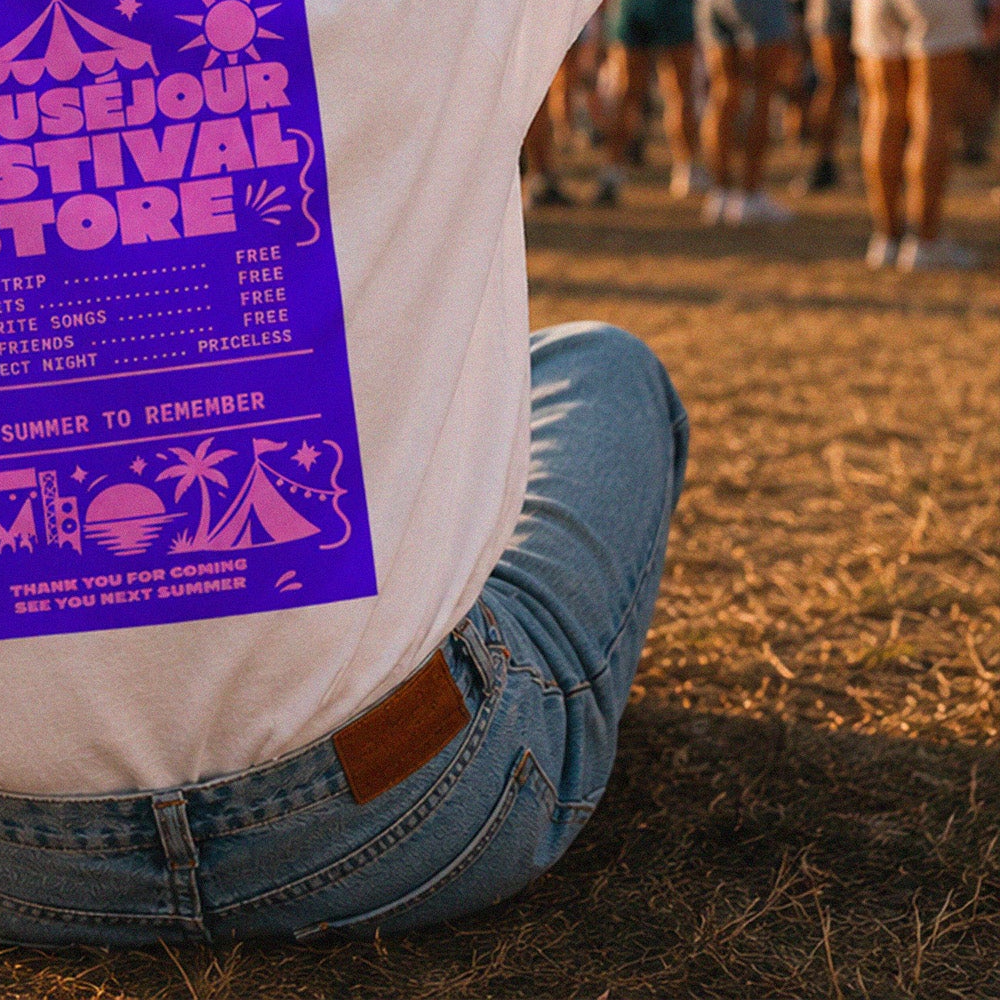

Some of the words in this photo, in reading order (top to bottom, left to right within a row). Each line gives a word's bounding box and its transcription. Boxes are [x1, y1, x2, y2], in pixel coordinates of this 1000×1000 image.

[1, 274, 46, 292] TRIP
[236, 246, 281, 264] FREE
[238, 267, 283, 285] FREE
[50, 310, 107, 329] SONGS
[240, 288, 286, 306] FREE
[243, 309, 288, 327] FREE
[43, 353, 97, 372] NIGHT
[198, 329, 292, 353] PRICELESS
[1, 415, 89, 443] SUMMER
[102, 409, 132, 430] TO
[145, 391, 265, 425] REMEMBER
[9, 579, 78, 597] THANK
[82, 574, 122, 589] YOU
[127, 569, 165, 584] FOR
[170, 558, 247, 579] COMING
[14, 600, 51, 614] SEE
[55, 595, 96, 610] YOU
[101, 588, 152, 605] NEXT
[157, 576, 246, 598] SUMMER
